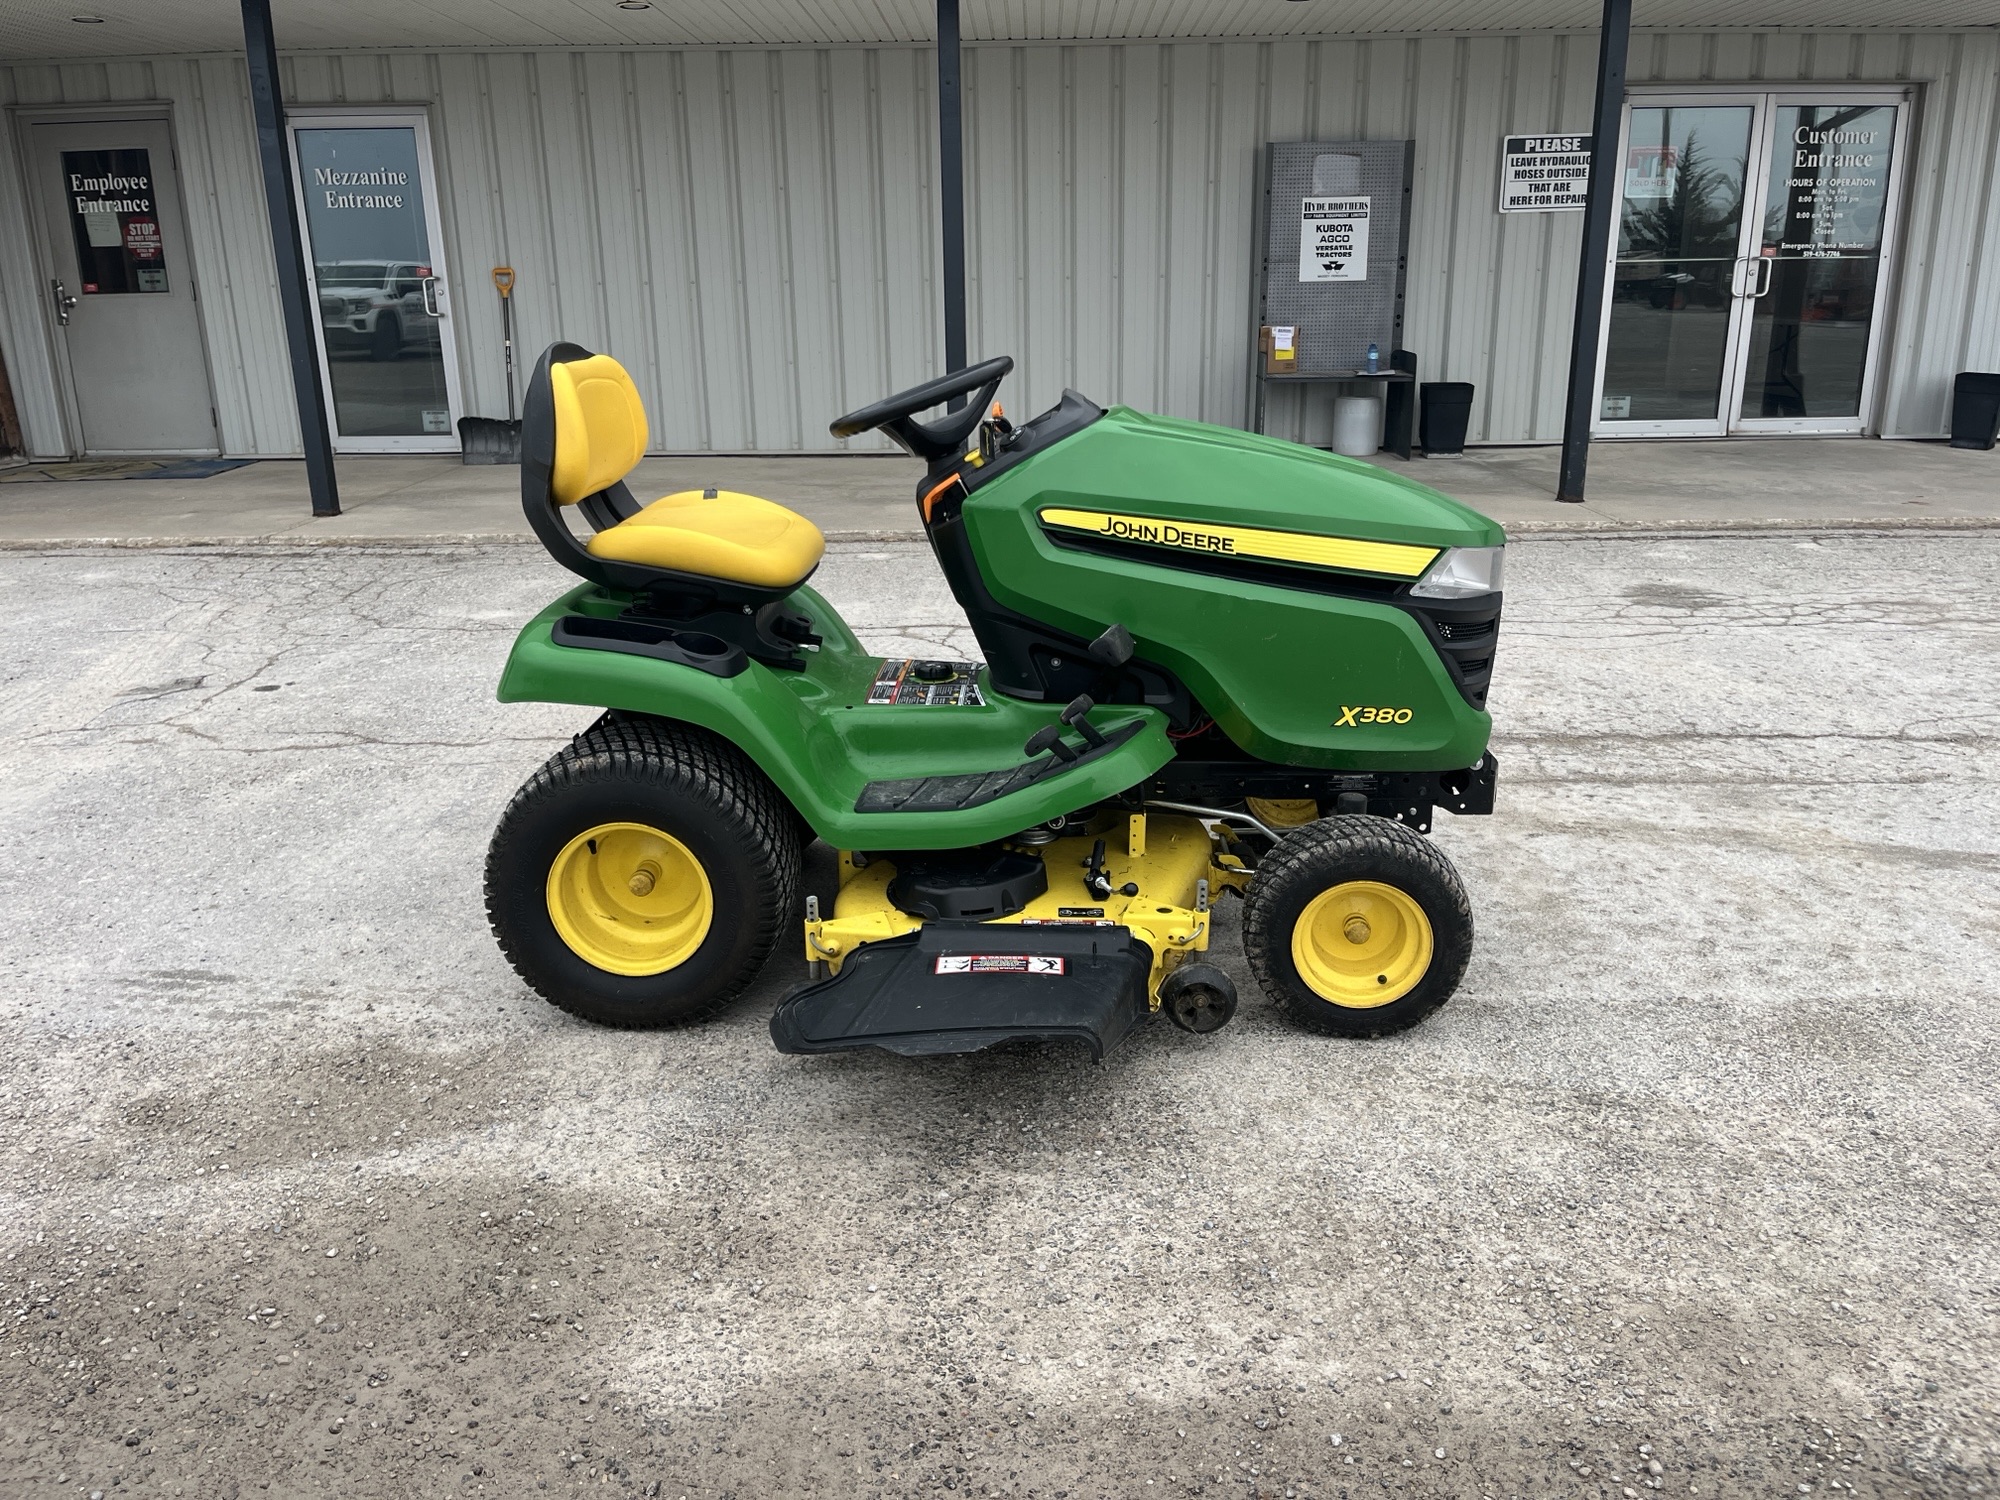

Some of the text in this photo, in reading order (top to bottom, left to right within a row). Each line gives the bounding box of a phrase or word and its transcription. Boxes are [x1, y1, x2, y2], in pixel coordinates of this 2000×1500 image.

[1794, 126, 1878, 145] Customer
[1524, 138, 1581, 153] PLEASE
[1510, 156, 1538, 167] LEAVE
[1794, 149, 1873, 168] Entrance
[314, 166, 408, 186] Mezzanine
[1514, 168, 1587, 179] HOSES OUTSIDE
[69, 172, 148, 195] Employee
[1528, 182, 1571, 193] THAT ARE
[1784, 178, 1876, 187] HOURS OF OPERATION
[75, 196, 150, 214] Entrance
[325, 190, 403, 209] Entrance
[1509, 194, 1587, 206] HERE FOR REPAIR
[1304, 201, 1369, 212] HYDE BROTHERS
[128, 223, 156, 236] STOP
[1315, 224, 1353, 233] KUBOTA
[1319, 234, 1350, 243] AGCO
[1781, 242, 1816, 250] Emergency
[1100, 516, 1235, 552] JOHN DEERE
[1331, 704, 1414, 727] X380
